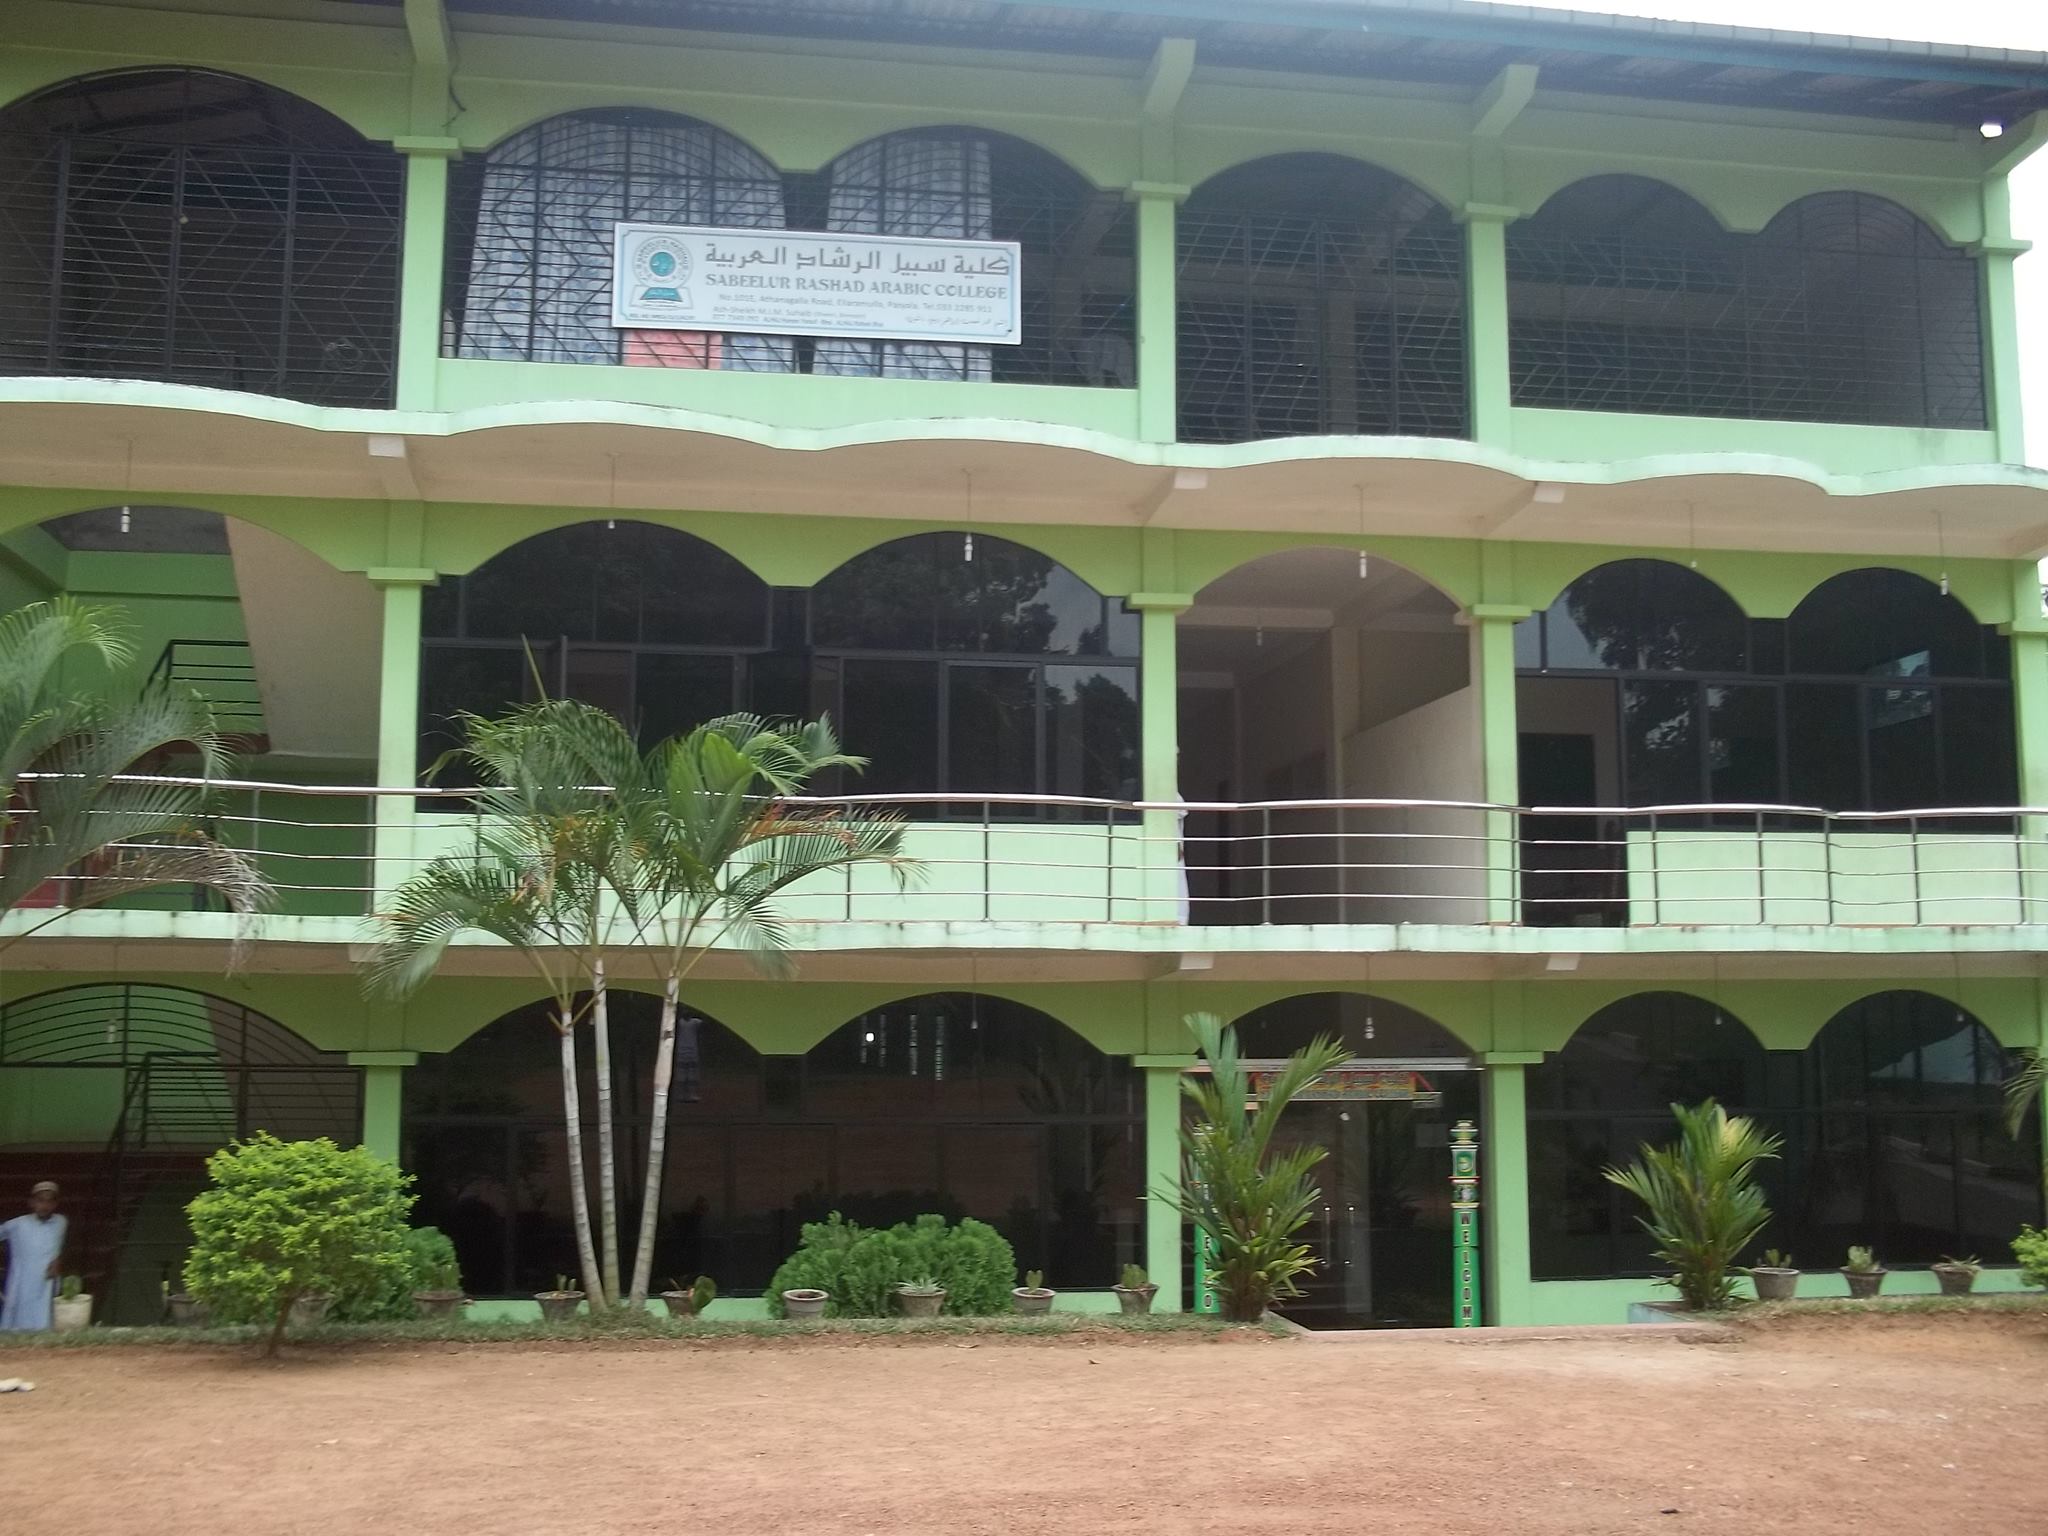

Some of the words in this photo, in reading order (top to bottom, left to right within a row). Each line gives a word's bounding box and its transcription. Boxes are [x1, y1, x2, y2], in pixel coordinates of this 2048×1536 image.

[705, 242, 787, 269] العربية
[796, 246, 881, 274] الرشاد
[890, 252, 946, 277] سبيل
[953, 254, 1010, 279] كلية
[705, 273, 791, 290] SABEELUR
[796, 277, 865, 294] RASHAD
[868, 281, 931, 296] ARABIC
[935, 284, 1008, 300] COLLEGE
[1459, 1211, 1473, 1328] WELCOM
